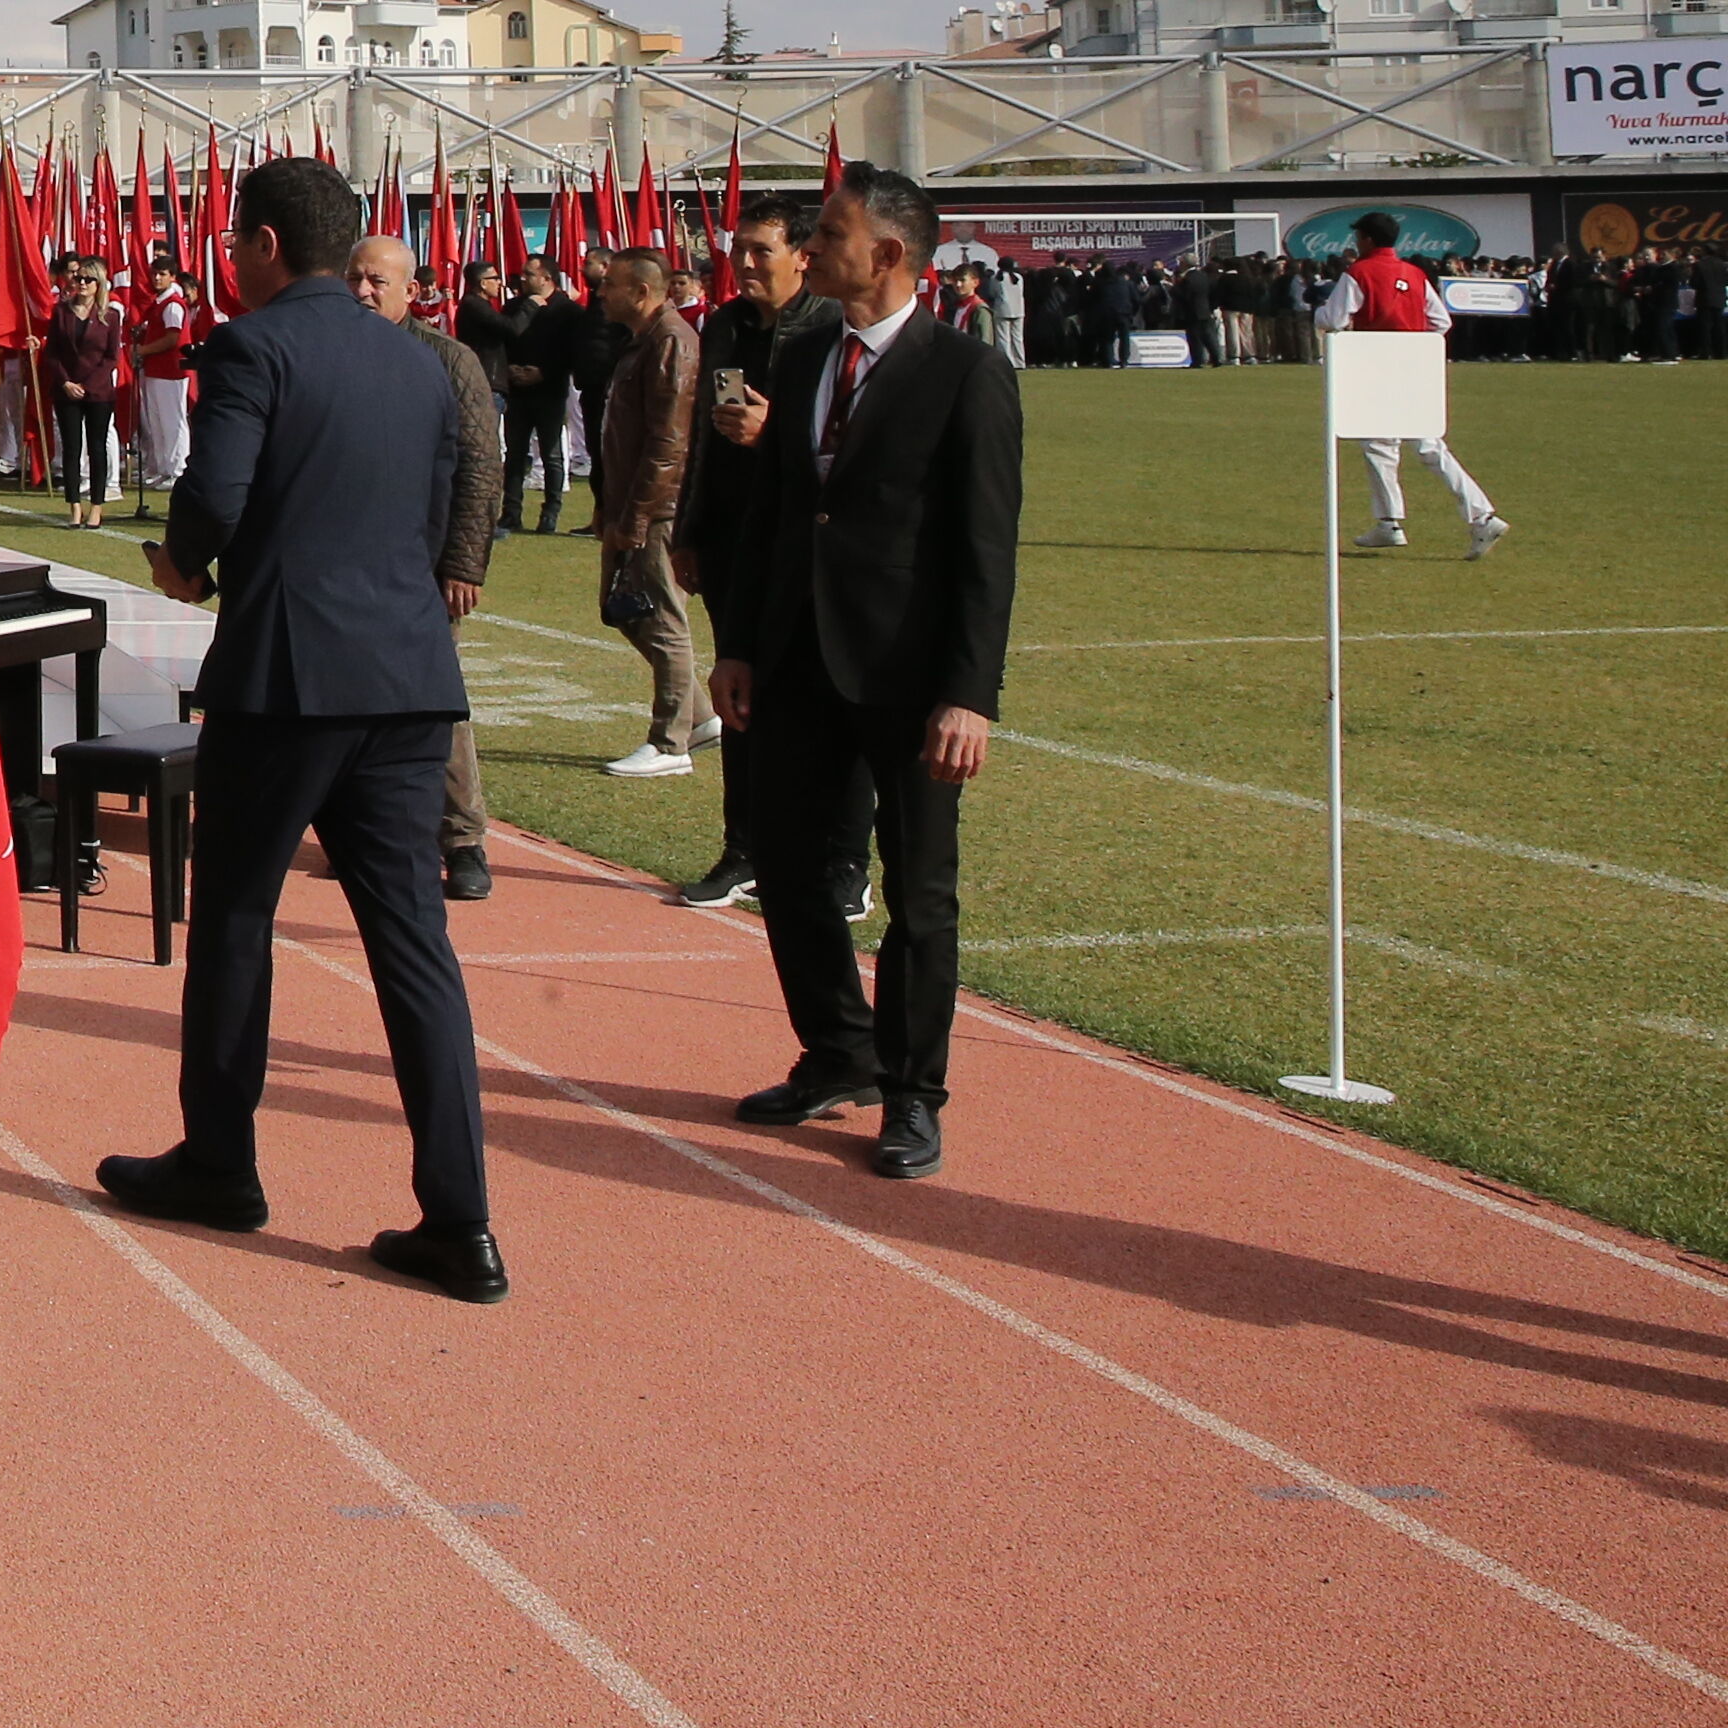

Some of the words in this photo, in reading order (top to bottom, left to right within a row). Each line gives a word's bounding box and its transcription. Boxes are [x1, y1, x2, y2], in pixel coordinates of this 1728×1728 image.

[1564, 60, 1725, 108] narç
[1606, 113, 1652, 129] Yuva
[1032, 234, 1095, 251] BAŞARILAR
